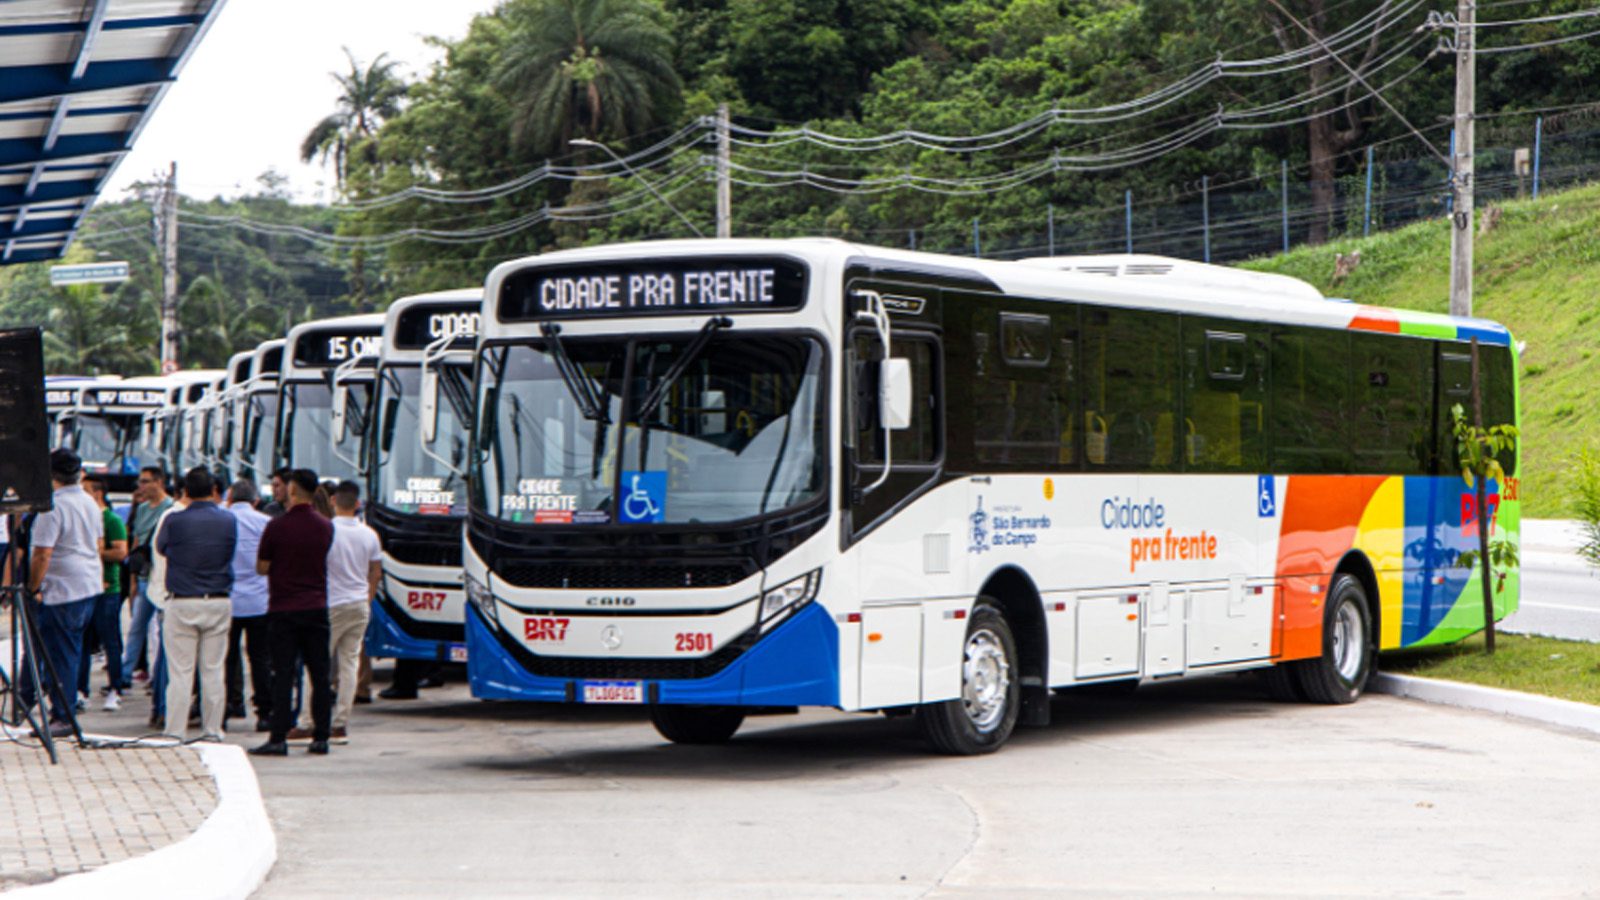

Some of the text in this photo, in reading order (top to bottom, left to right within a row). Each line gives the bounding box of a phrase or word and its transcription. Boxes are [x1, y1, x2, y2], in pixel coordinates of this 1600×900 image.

[540, 269, 775, 310] CIDADE PRA FRENTE
[429, 312, 480, 338] CIDAD
[328, 336, 348, 360] 15
[1011, 514, 1051, 529] Bernardo
[1101, 496, 1164, 529] Cidade
[992, 531, 1037, 548] do Campo
[1130, 527, 1217, 573] pra frente
[407, 591, 447, 611] BR7
[524, 618, 570, 641] BR7
[675, 633, 714, 652] 2501
